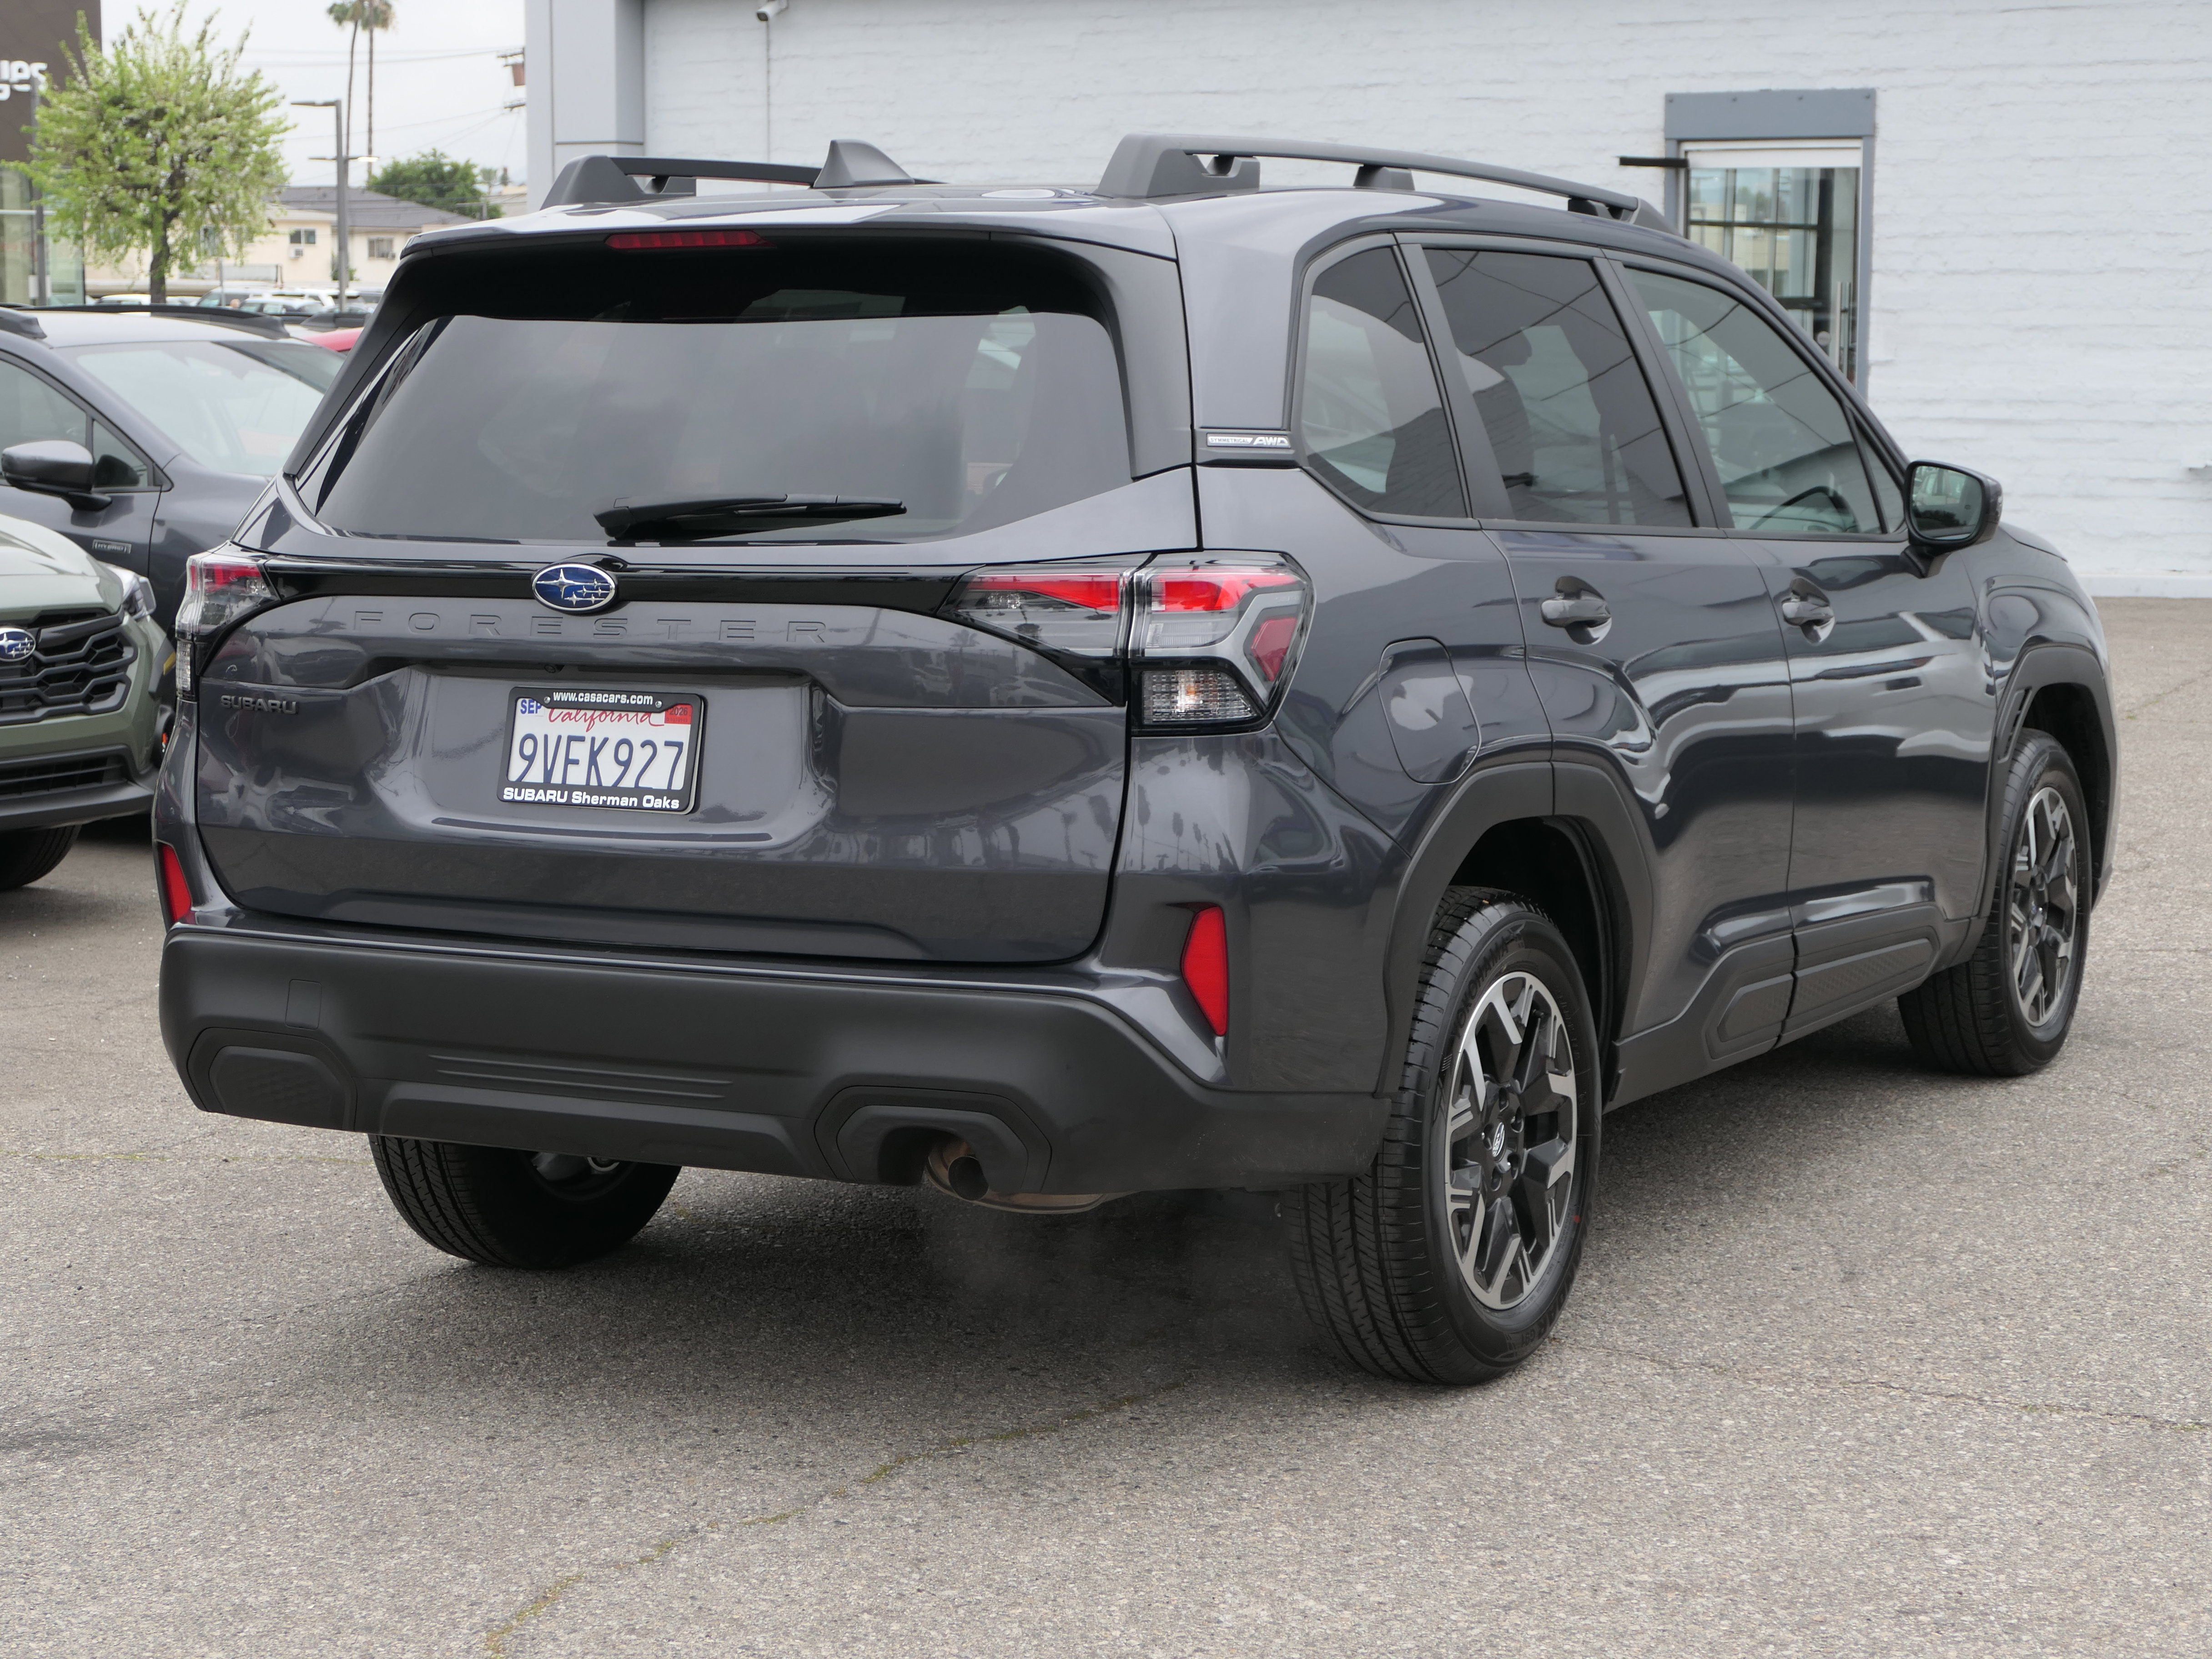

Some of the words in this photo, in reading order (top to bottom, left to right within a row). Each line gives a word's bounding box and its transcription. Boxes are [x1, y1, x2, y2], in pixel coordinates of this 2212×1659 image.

[1253, 436, 1290, 446] AWD
[354, 610, 827, 643] FORESTER
[221, 695, 298, 714] SUBARU
[520, 699, 543, 714] SEP
[553, 692, 653, 705] www.casacars.com
[548, 708, 664, 732] California
[669, 707, 688, 716] 2026
[514, 733, 684, 790] 9VFK927
[503, 787, 568, 803] SUBARU
[571, 791, 638, 807] Sherman
[642, 794, 680, 809] Oaks
[1450, 934, 1509, 1040] YOKOHAMA
